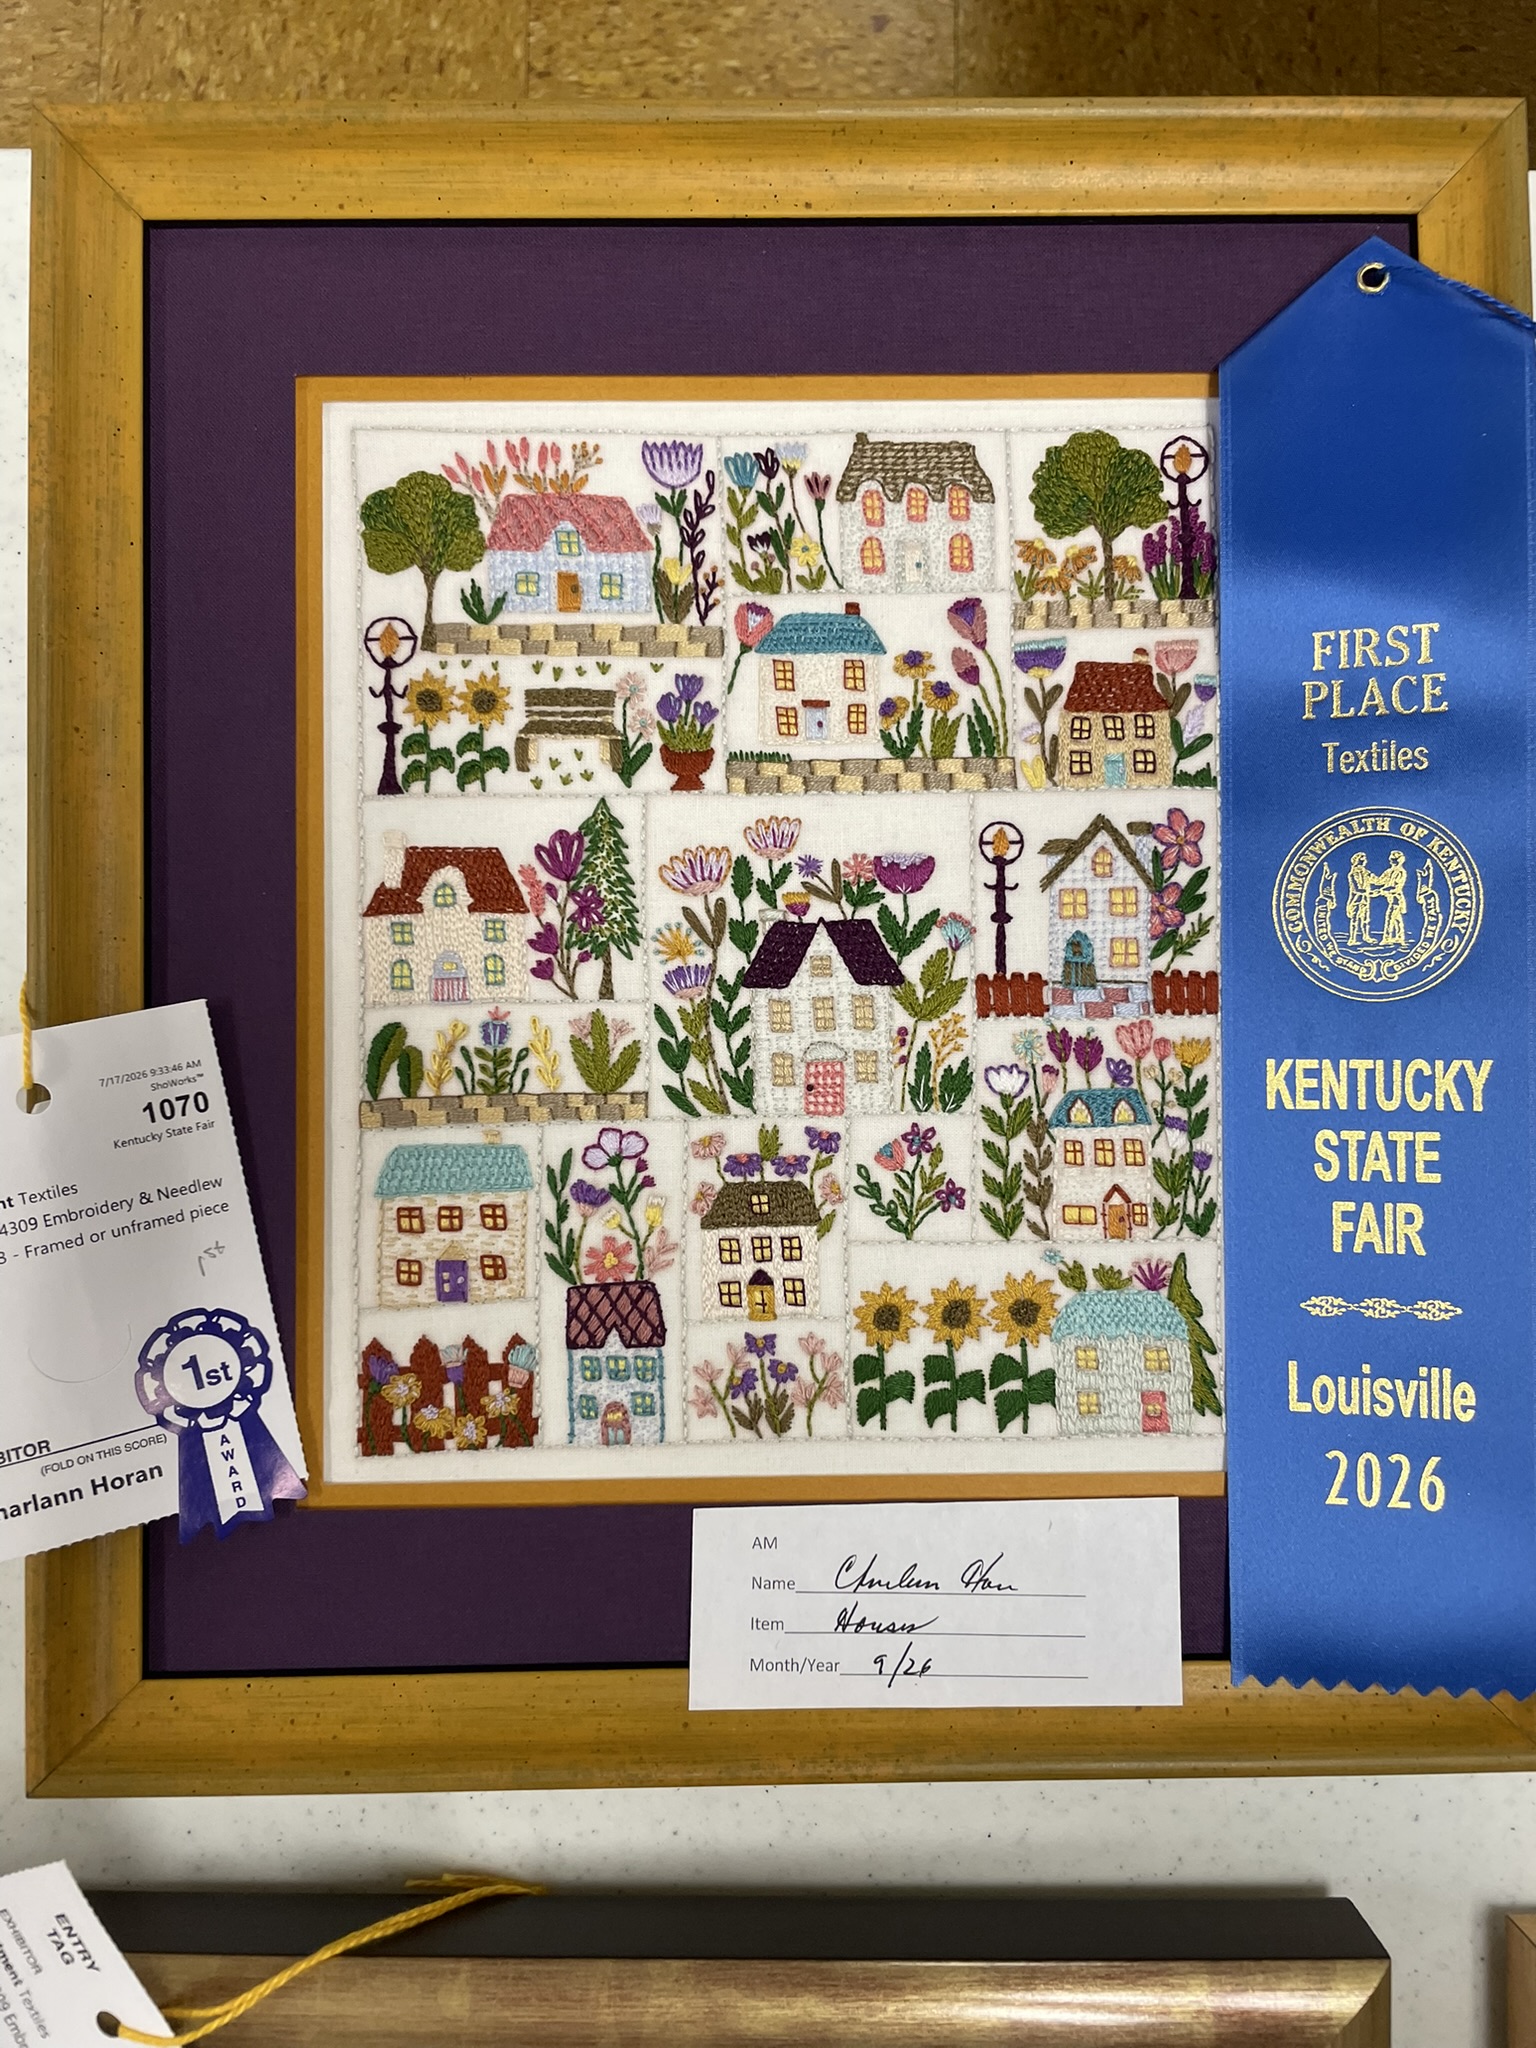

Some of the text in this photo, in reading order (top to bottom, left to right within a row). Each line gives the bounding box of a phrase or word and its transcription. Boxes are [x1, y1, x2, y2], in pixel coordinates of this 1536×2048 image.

[1312, 623, 1441, 671] FIRST
[1302, 674, 1449, 720] PLACE
[1321, 739, 1430, 775] Textiles
[1285, 817, 1472, 933] COMMONWEALTH OF KENTUCKY
[1317, 905, 1328, 941] UNITED
[98, 1059, 202, 1088] 7/17/2026 9:33:46 AM
[1265, 1058, 1494, 1112] KENTUCKY
[142, 1091, 209, 1123] 1070
[113, 1120, 215, 1150] Kentucky State Fair
[1313, 1129, 1442, 1183] STATE
[0, 1177, 223, 1236] 4309 Embroidery & Needlew
[17, 1184, 78, 1205] Textiles
[24, 1233, 84, 1258] Framed
[89, 1230, 107, 1243] or
[111, 1209, 185, 1238] unframed
[190, 1202, 230, 1223] piece
[1332, 1201, 1427, 1256] FAIR
[181, 1354, 233, 1390] 1st
[1287, 1360, 1477, 1422] Louisville
[41, 1433, 167, 1477] (FOLD ON THIS SCORE)
[219, 1433, 247, 1509] AWARD
[90, 1464, 164, 1496] Horan
[1325, 1450, 1446, 1512] 2026
[751, 1536, 779, 1550] AM
[751, 1576, 796, 1590] Name
[750, 1617, 785, 1631] Item
[750, 1657, 840, 1673] Month/Year
[873, 1641, 933, 1688] 9/26
[47, 1927, 75, 1965] TAG
[55, 1913, 101, 1972] ENTRY
[19, 1988, 50, 2039] Textiles
